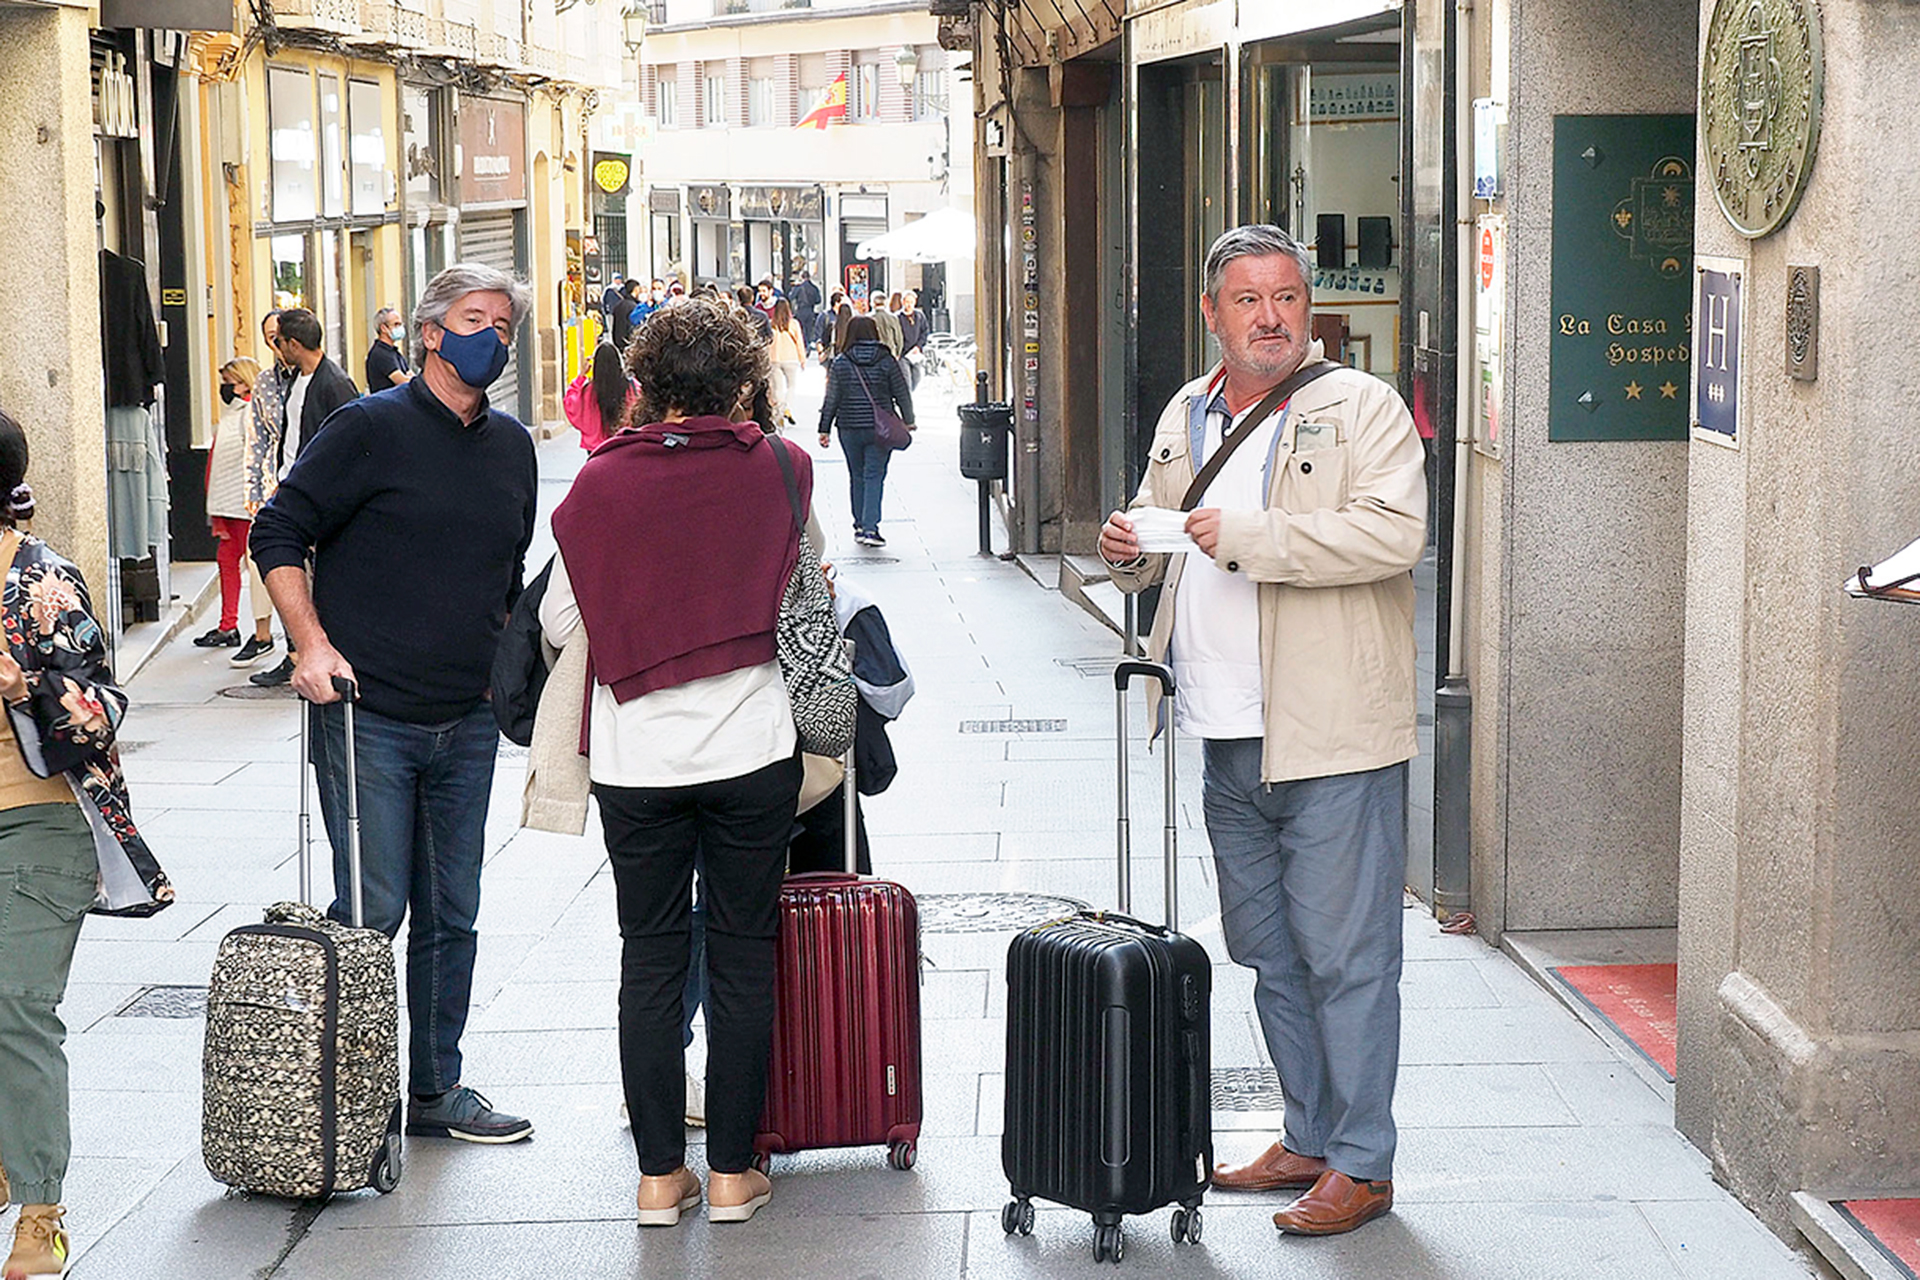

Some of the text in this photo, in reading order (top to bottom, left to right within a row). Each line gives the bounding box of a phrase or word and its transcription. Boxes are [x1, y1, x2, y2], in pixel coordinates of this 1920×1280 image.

[1558, 314, 1592, 336] La
[1607, 313, 1668, 336] Casa
[1705, 294, 1730, 371] H
